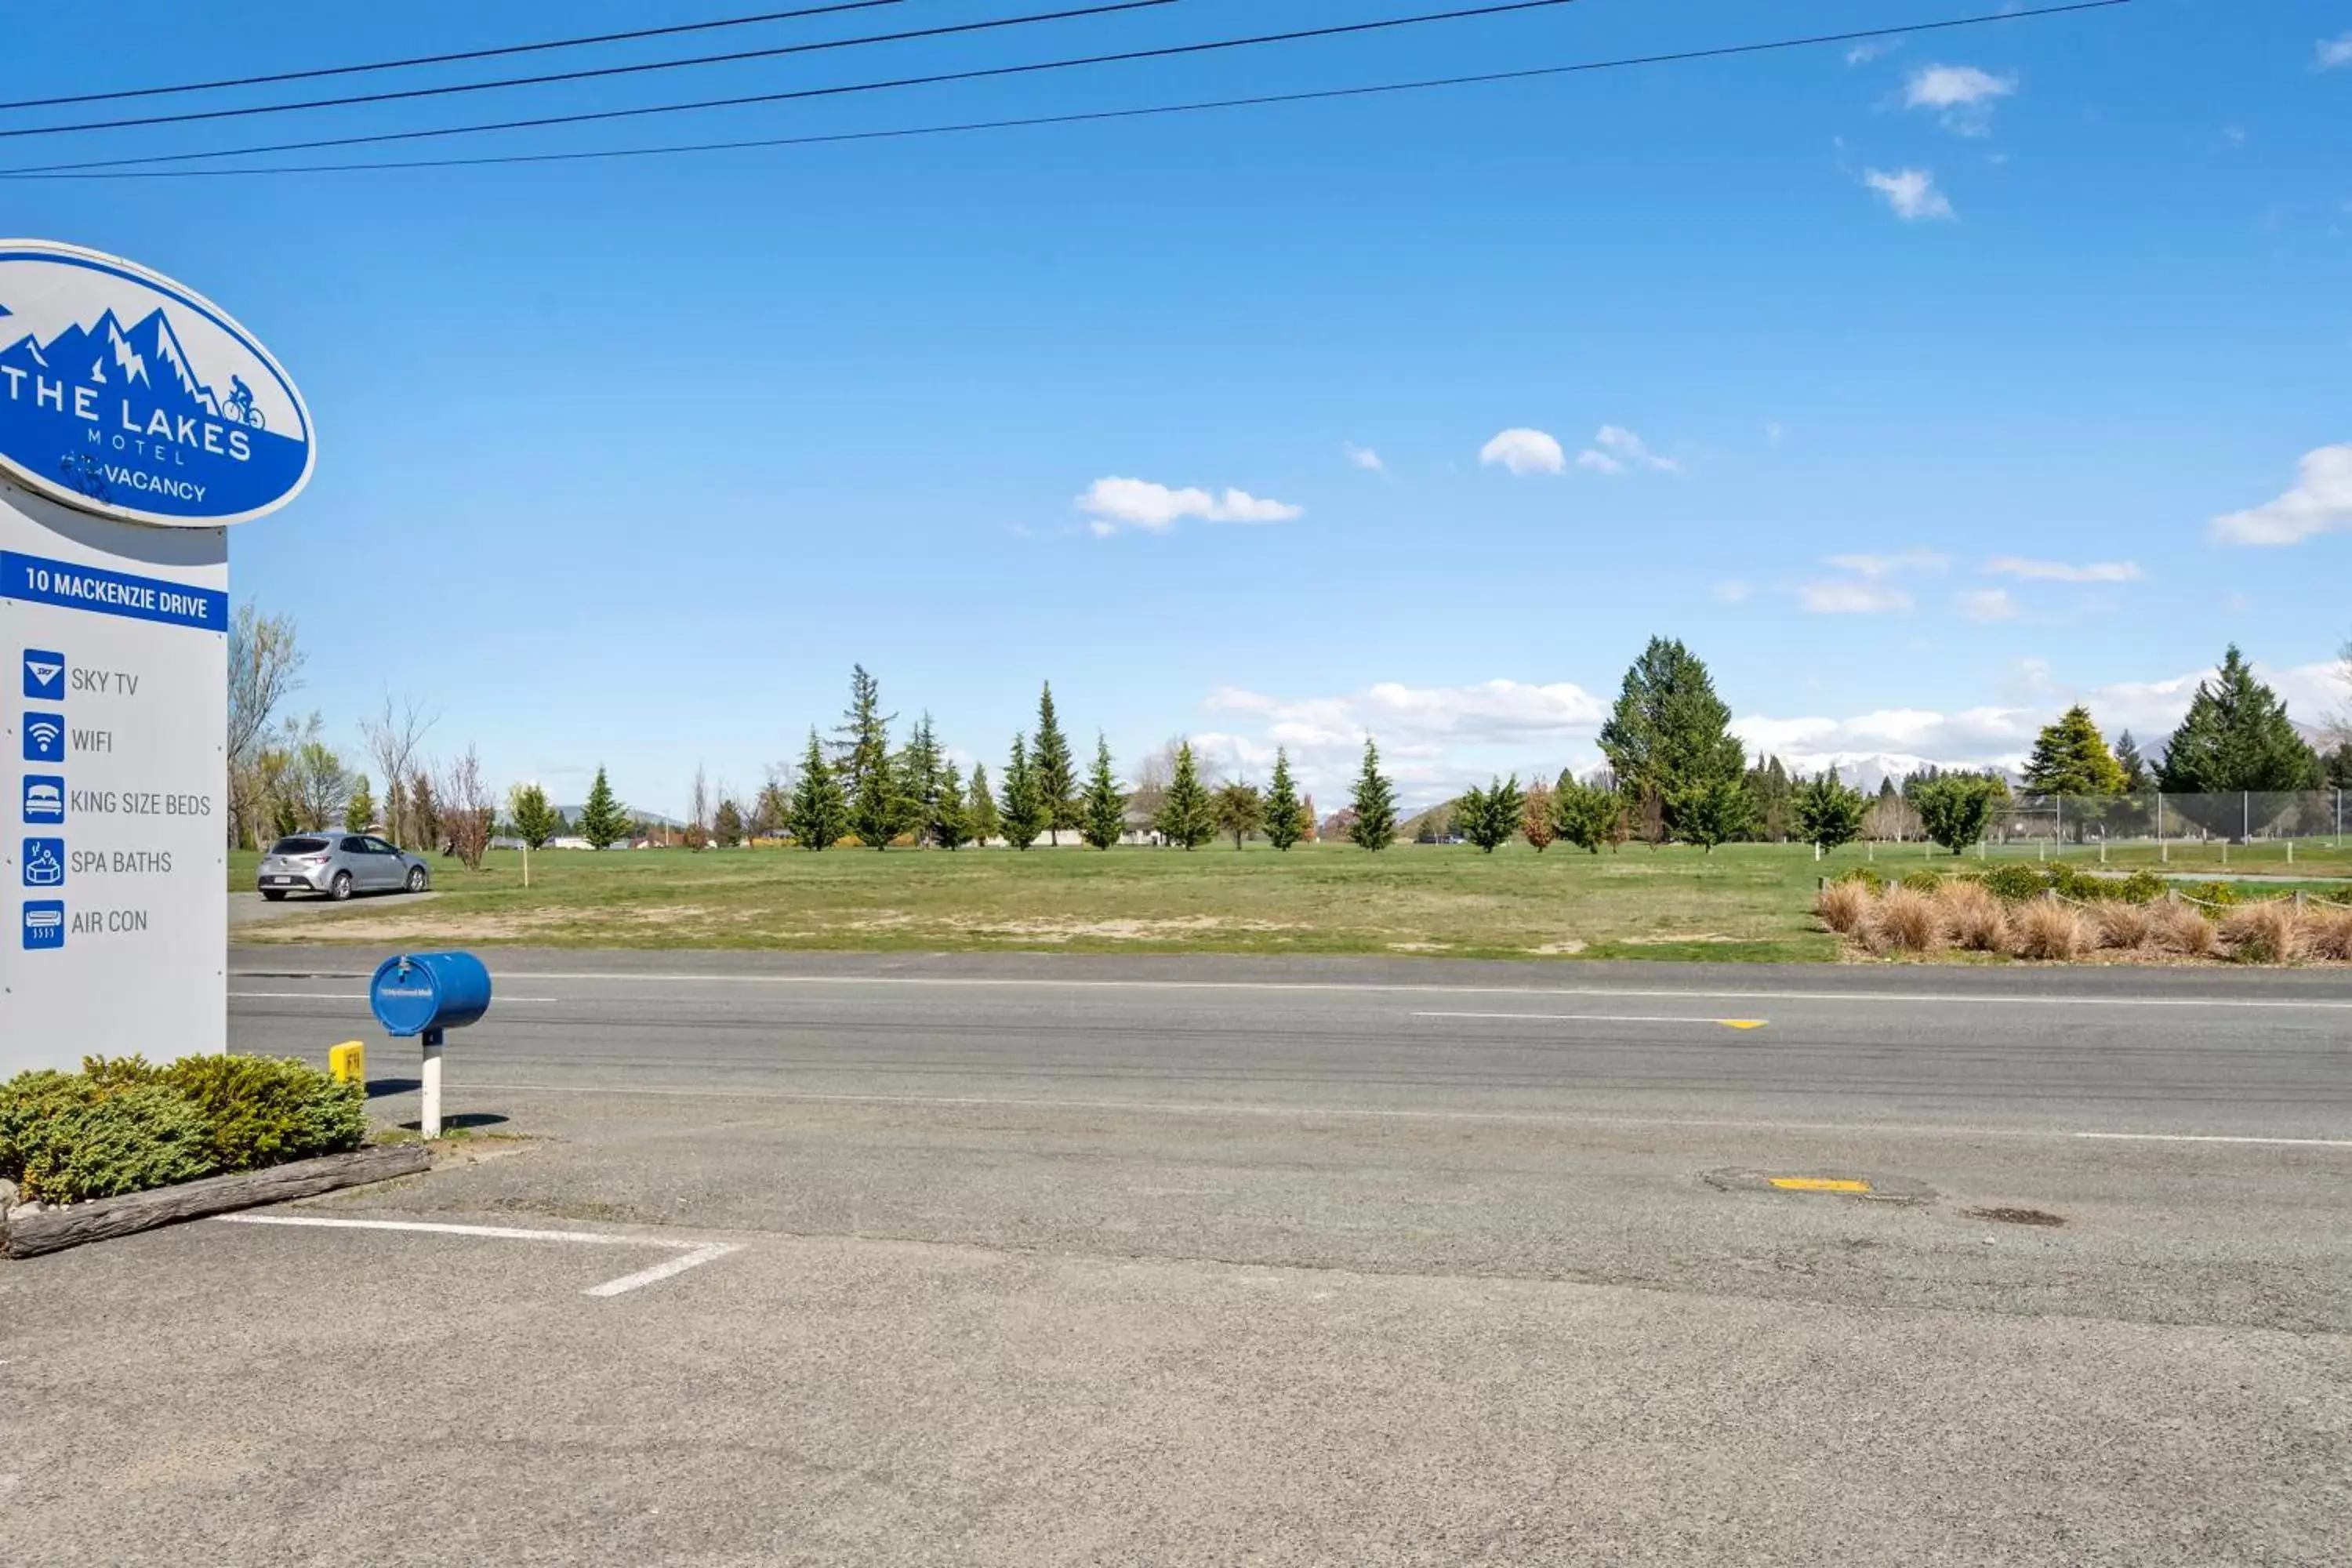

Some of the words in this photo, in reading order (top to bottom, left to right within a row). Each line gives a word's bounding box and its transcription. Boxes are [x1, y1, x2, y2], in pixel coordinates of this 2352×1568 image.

[1, 365, 100, 422] THE
[122, 399, 251, 462] LAKES
[88, 428, 185, 466] MOTEL
[104, 463, 207, 503] VACANCY
[26, 567, 49, 591] 10
[54, 573, 156, 610] MACKENZIE
[159, 592, 208, 619] DRIVE
[71, 668, 110, 692] SKY
[114, 673, 139, 696] TV
[72, 728, 112, 753] WIFI
[71, 790, 117, 814] KING
[122, 793, 161, 815] SIZE
[165, 794, 211, 816] BEDS
[71, 851, 107, 873] SPA
[114, 851, 172, 873] BATHS
[71, 911, 103, 934] AIR
[109, 910, 147, 932] CON
